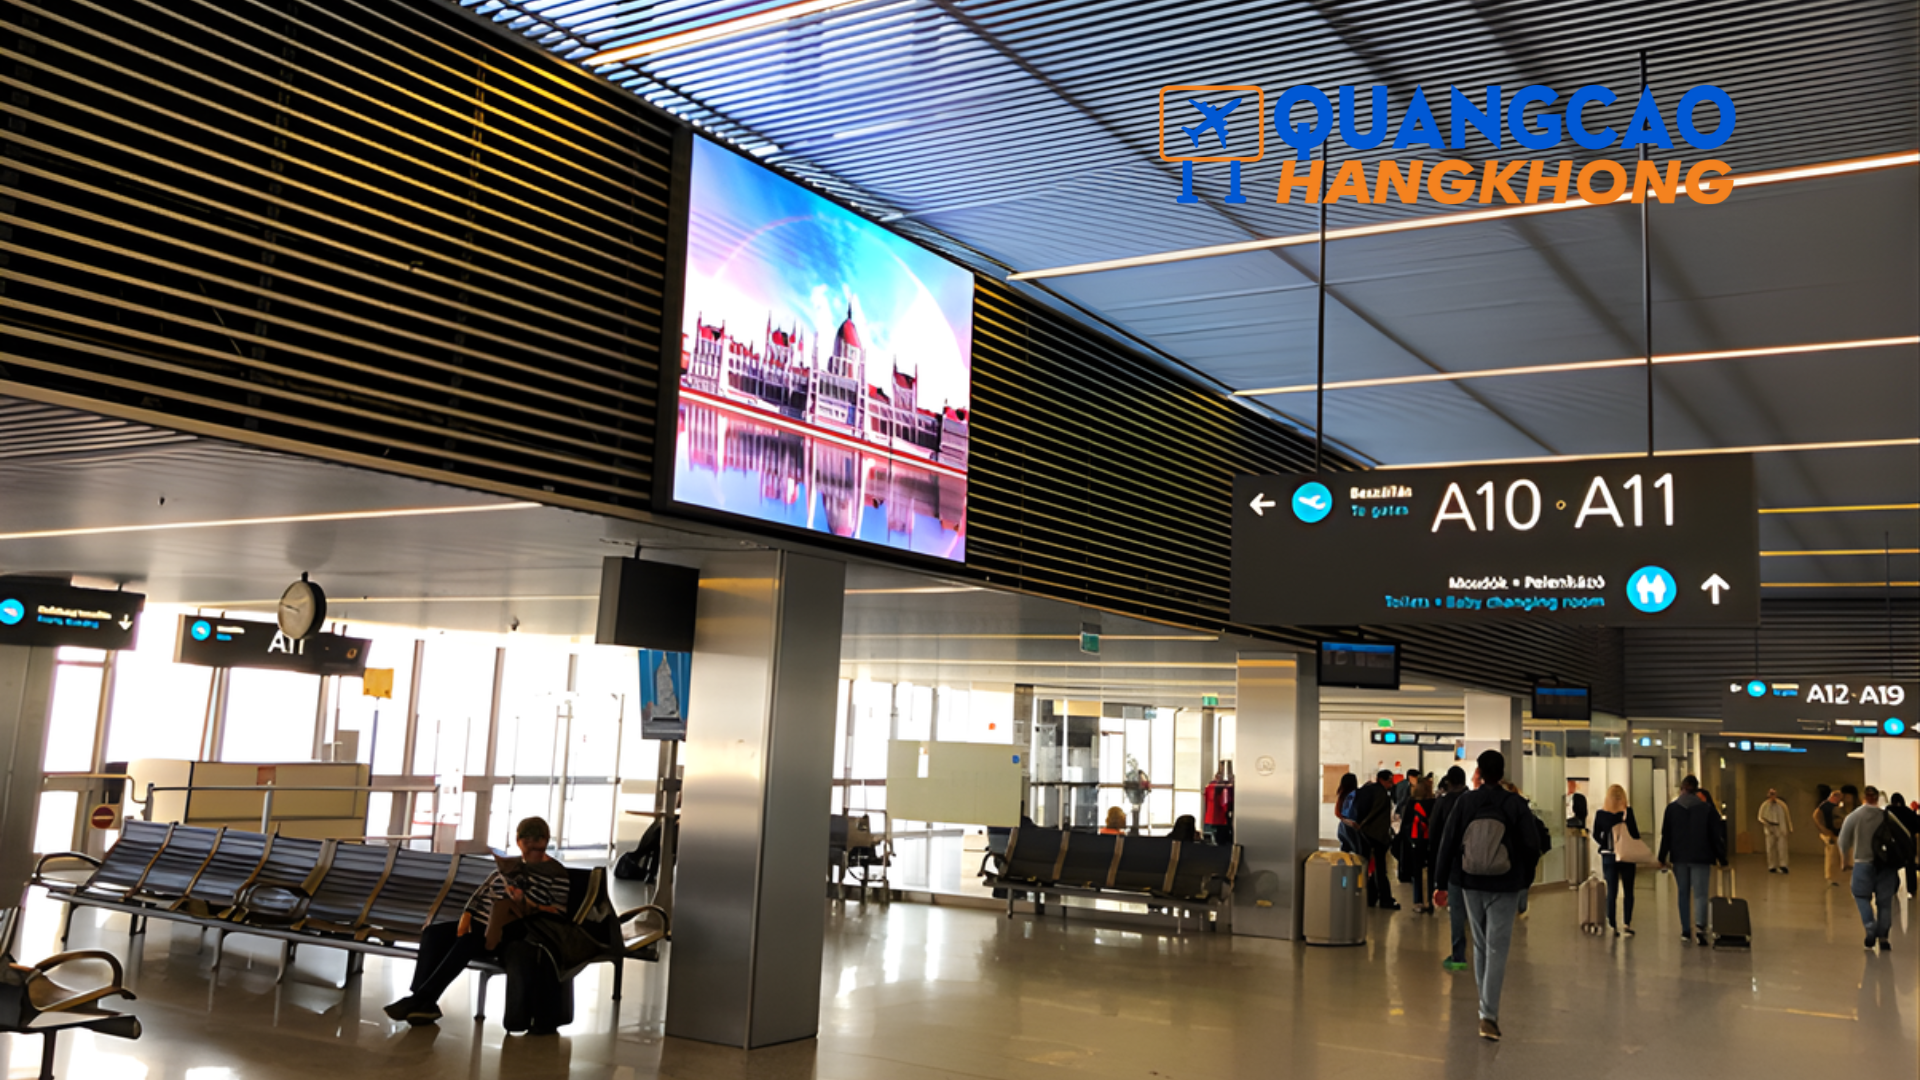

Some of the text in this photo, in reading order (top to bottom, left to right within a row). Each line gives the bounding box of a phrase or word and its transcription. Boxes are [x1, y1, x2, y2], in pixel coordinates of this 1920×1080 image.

[1432, 473, 1675, 532] A10 A11
[1806, 684, 1905, 706] A12 A19
